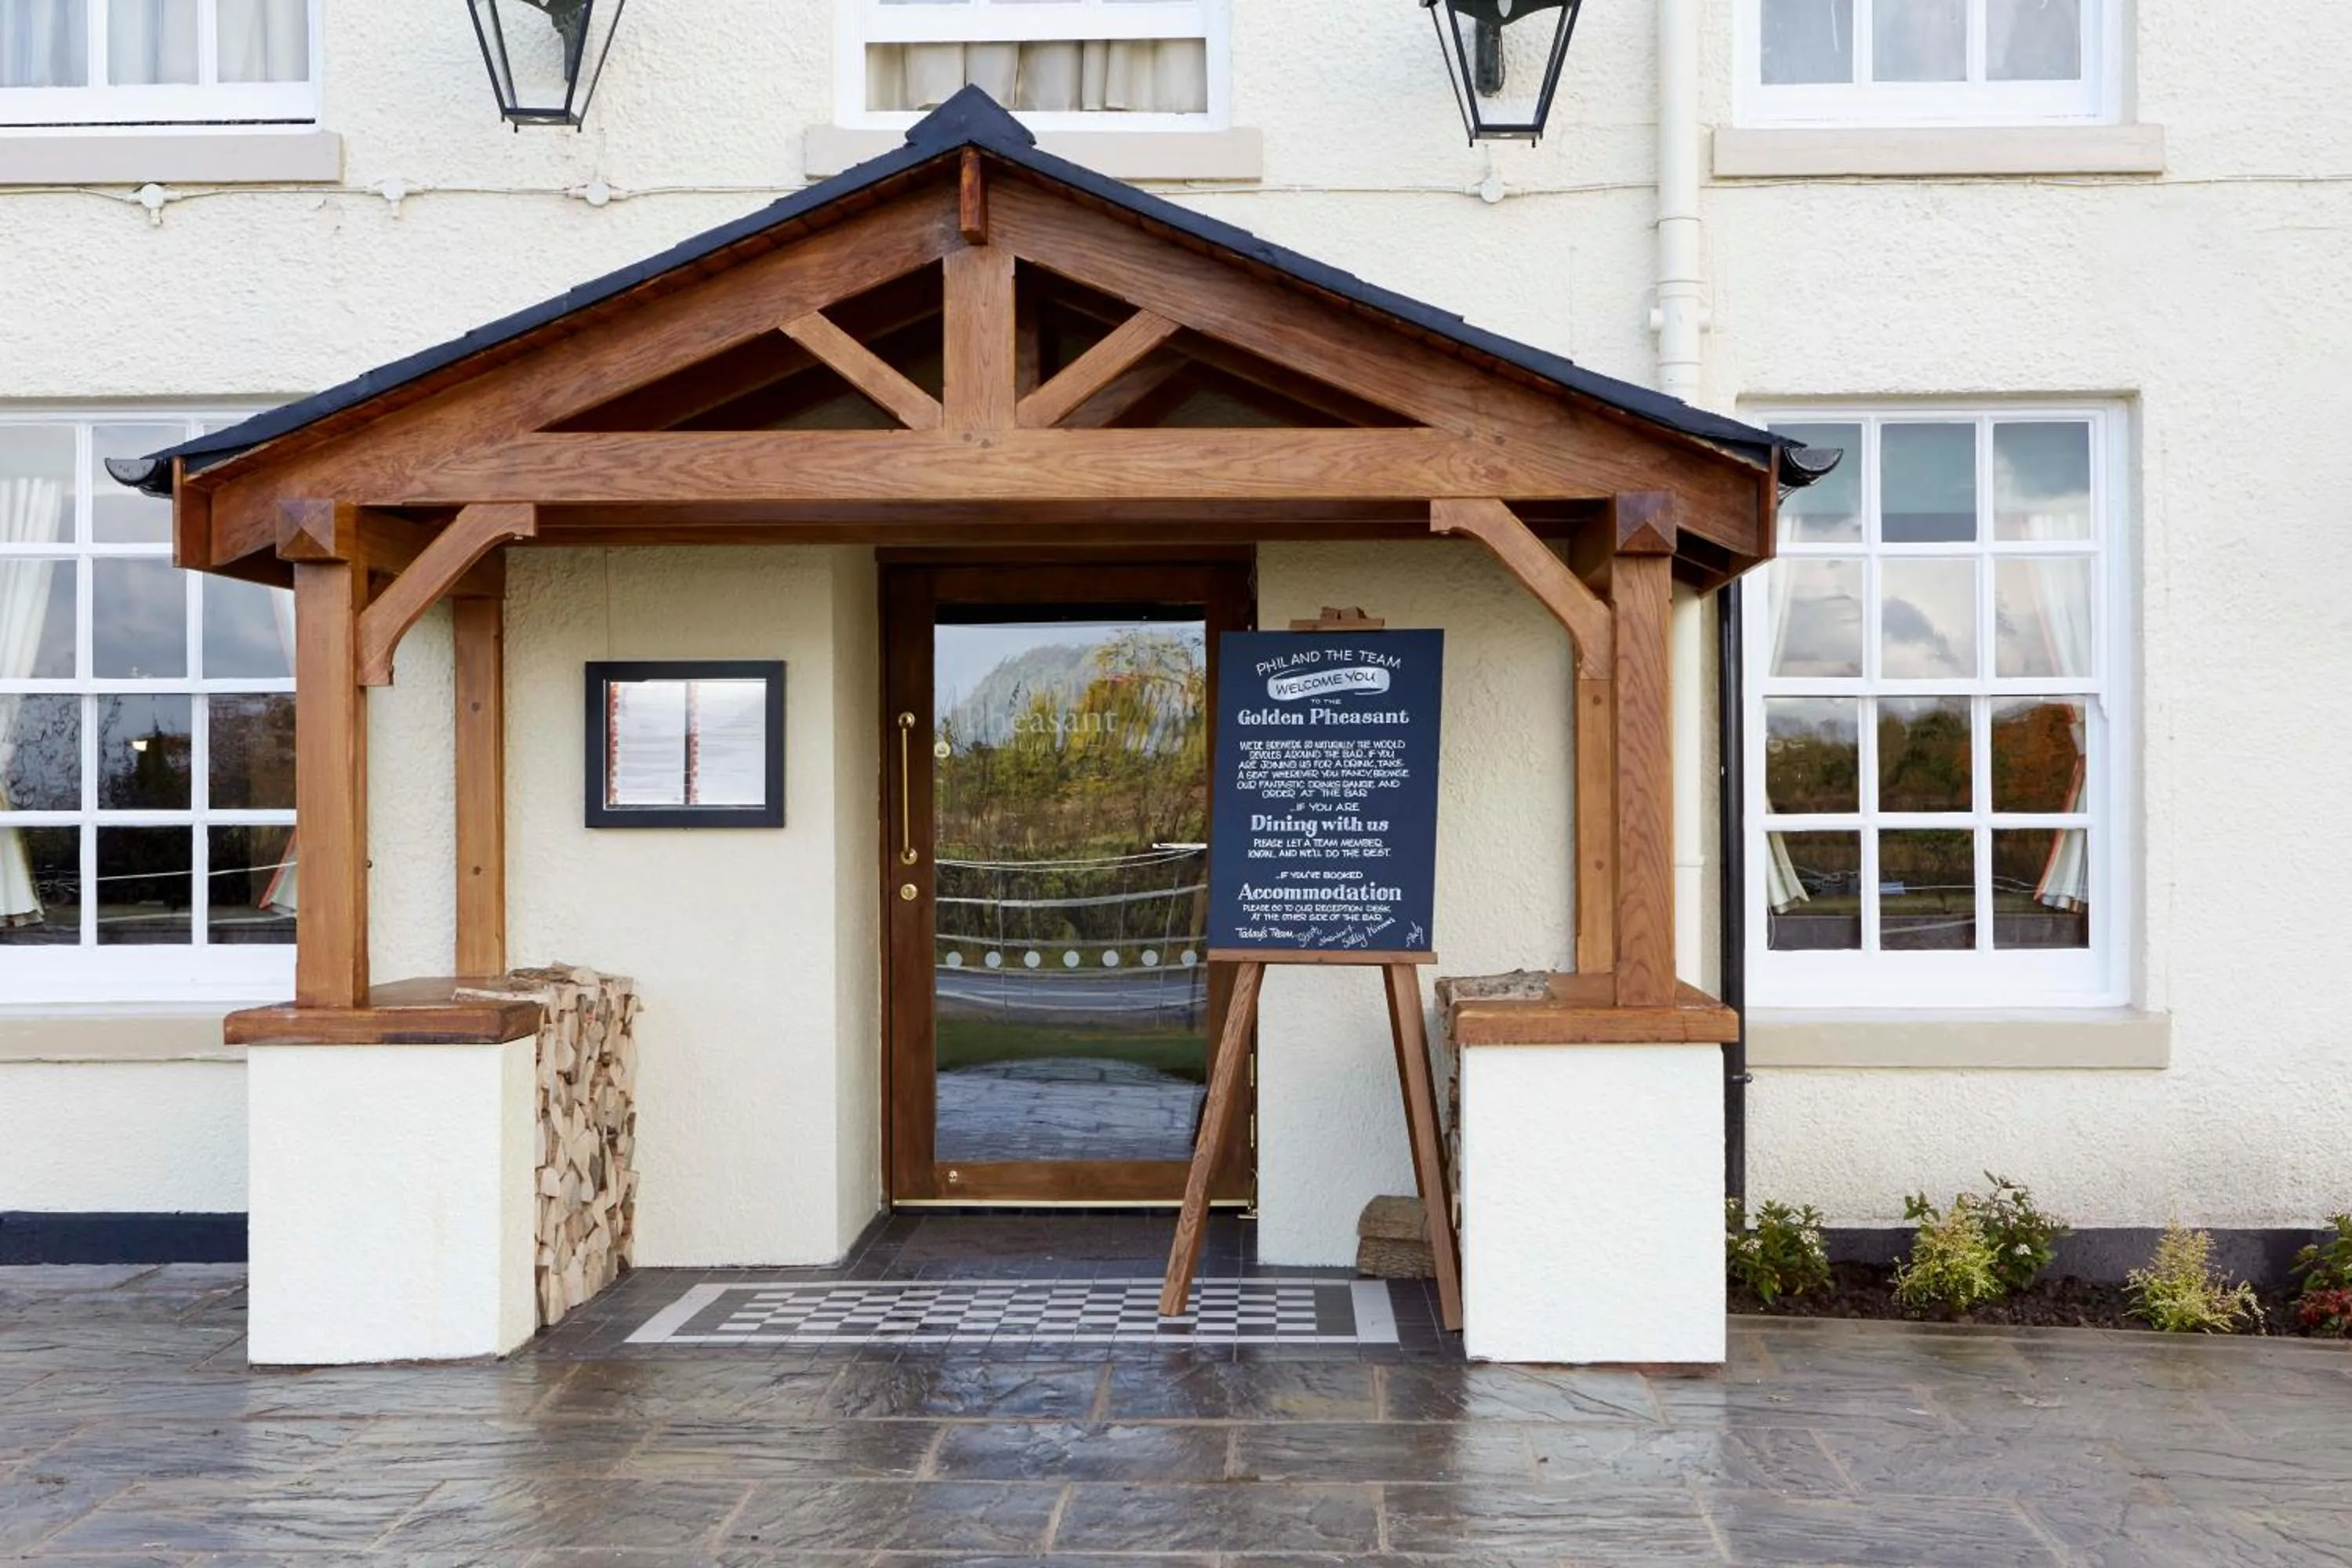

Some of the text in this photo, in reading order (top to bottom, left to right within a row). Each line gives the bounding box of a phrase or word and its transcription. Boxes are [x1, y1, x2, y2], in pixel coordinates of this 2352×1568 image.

[1256, 649, 1401, 676] PHIL AND THE TEAM
[1276, 671, 1376, 695] WELCOME YOU
[1237, 708, 1410, 725] Golden Pheasant
[1314, 760, 1333, 768] FOR
[1334, 760, 1342, 768] A
[1378, 779, 1400, 788] AND
[1262, 789, 1296, 798] ORDER
[1323, 789, 1341, 797] THE
[1308, 803, 1332, 811] YOU
[1335, 802, 1361, 811] ARE
[1250, 815, 1389, 837] Dining with us
[1254, 838, 1283, 847] PLEASE
[1287, 838, 1303, 847] LET
[1304, 838, 1311, 847] A
[1312, 838, 1338, 847] TEAM
[1326, 849, 1340, 858] DO
[1341, 849, 1360, 858] THE
[1323, 871, 1363, 880] BOOKED
[1238, 881, 1403, 902] Accommodation
[1295, 904, 1313, 913] OUR
[1315, 904, 1363, 913] RECEPTION
[1250, 913, 1261, 921] AT
[1263, 913, 1279, 921] THE
[1281, 913, 1307, 921] OTHER
